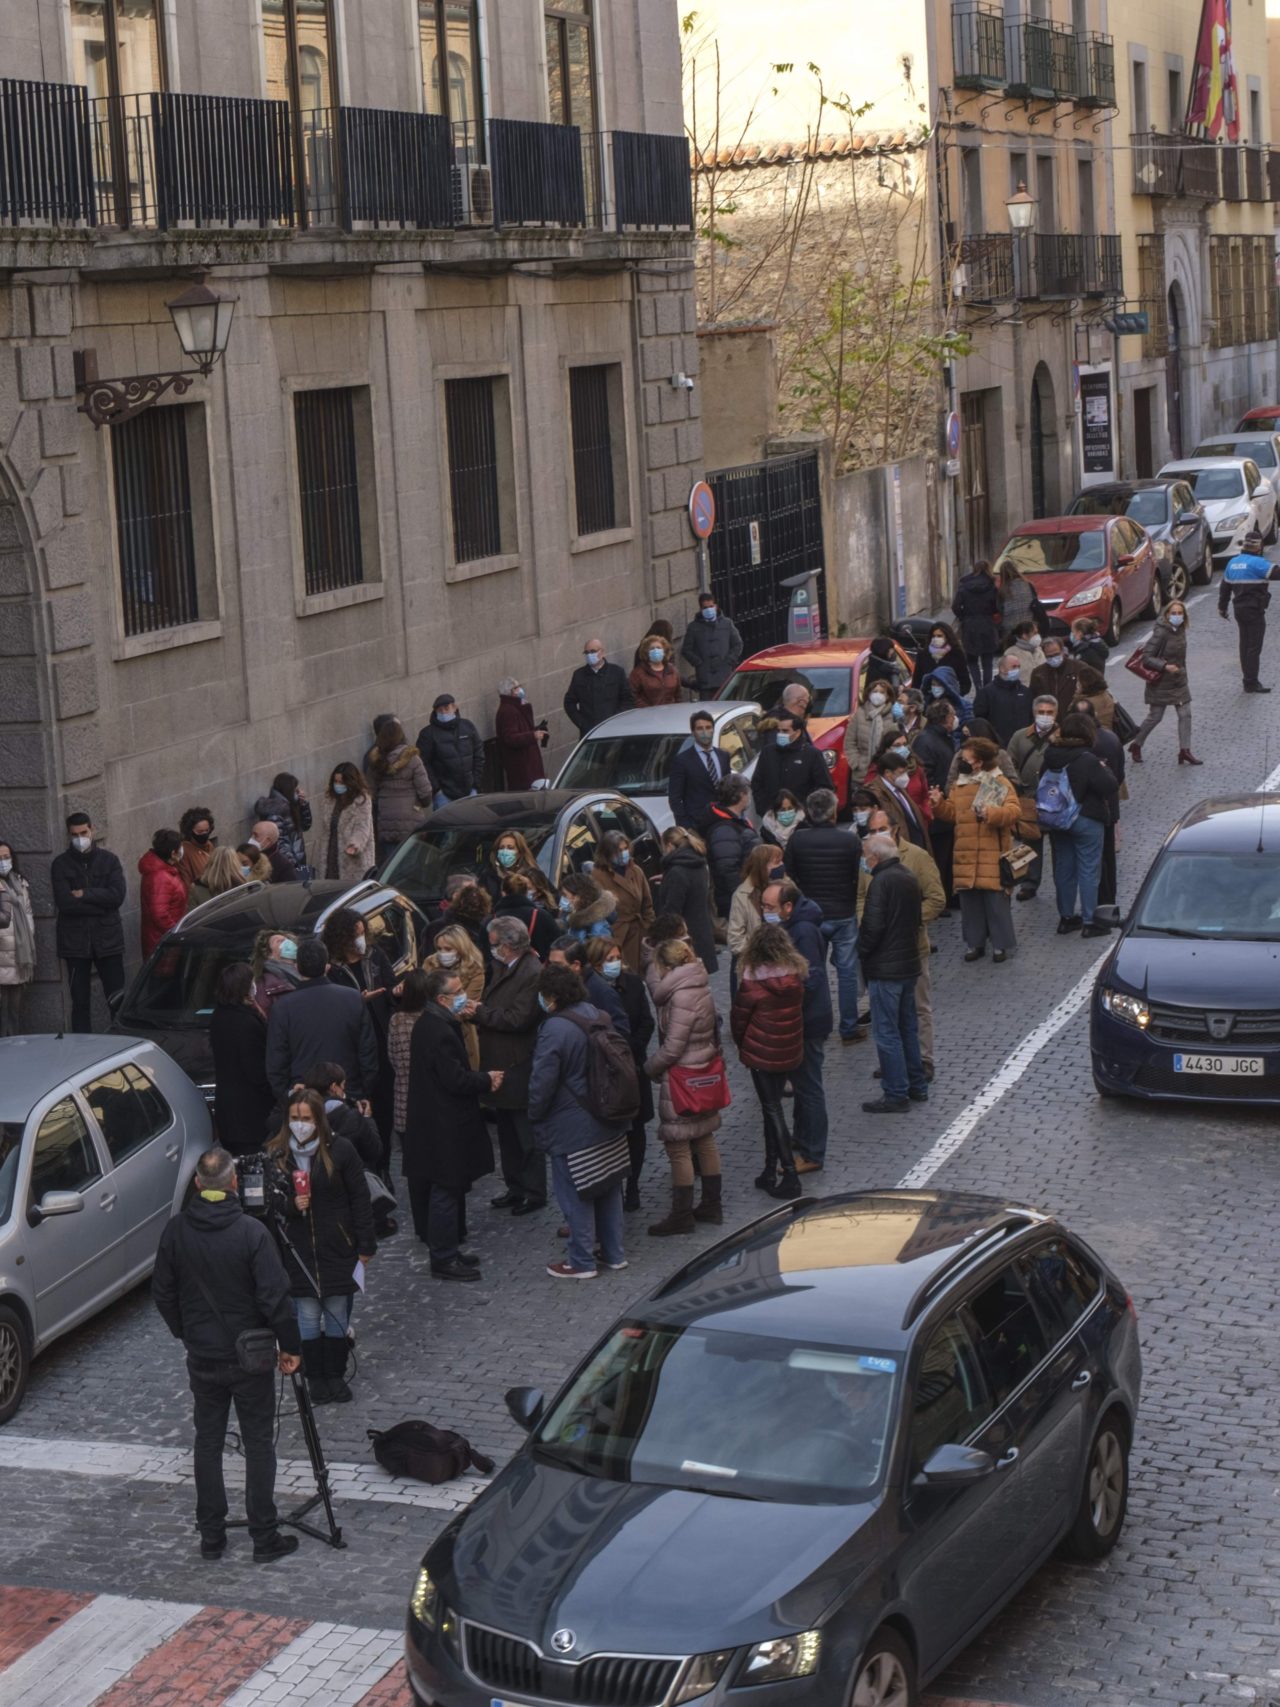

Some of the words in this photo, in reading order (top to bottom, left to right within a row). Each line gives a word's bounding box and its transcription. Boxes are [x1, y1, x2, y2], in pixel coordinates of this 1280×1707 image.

[796, 589, 807, 603] P
[1185, 1056, 1223, 1072] 4430
[1230, 1059, 1260, 1073] JGC
